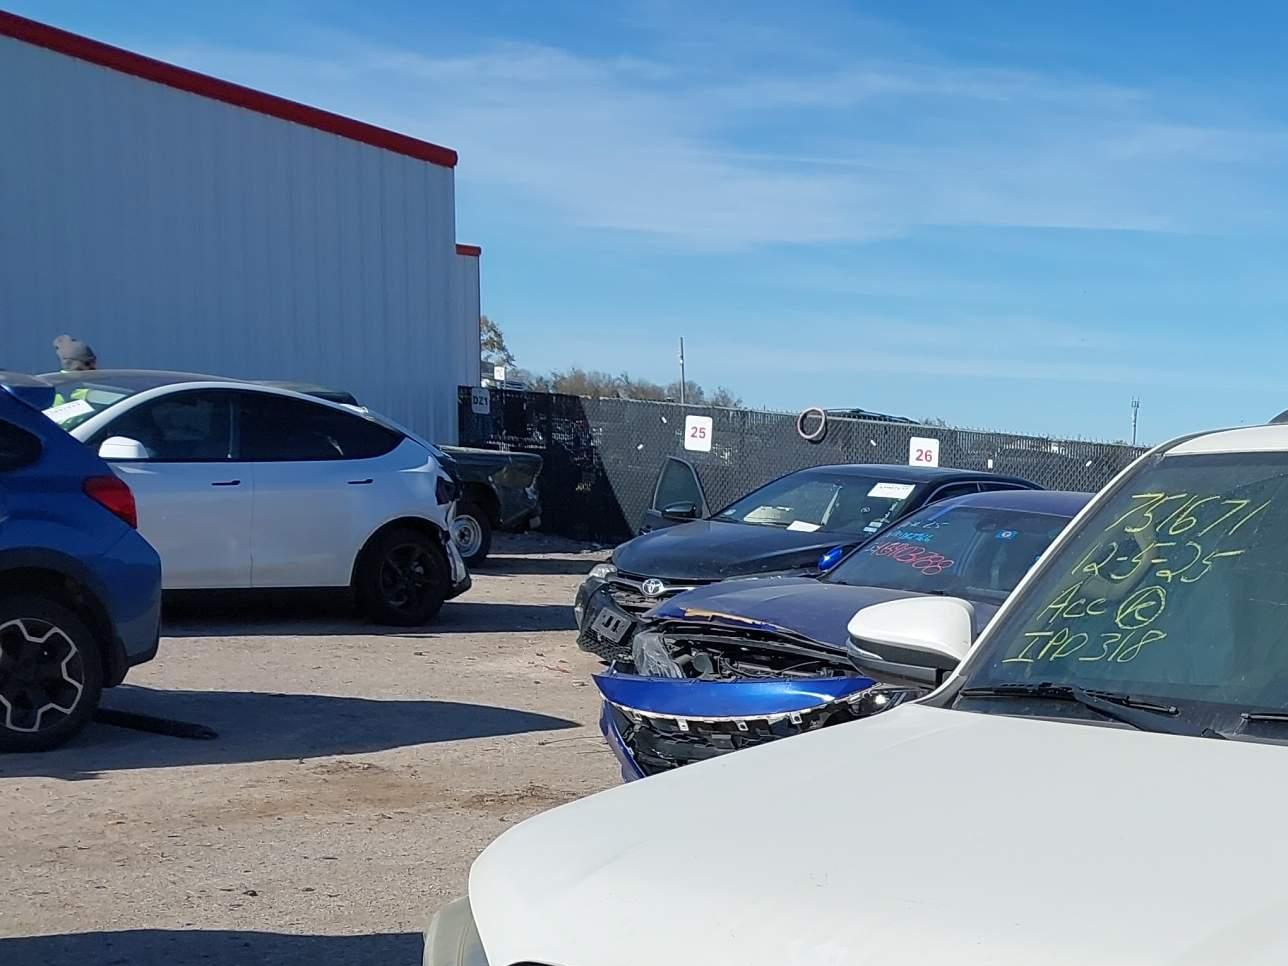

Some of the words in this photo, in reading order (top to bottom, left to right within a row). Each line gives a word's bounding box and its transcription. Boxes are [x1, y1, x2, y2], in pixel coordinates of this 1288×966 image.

[691, 426, 706, 438] 25
[915, 448, 933, 462] 26
[1072, 541, 1245, 583] 12-5-25
